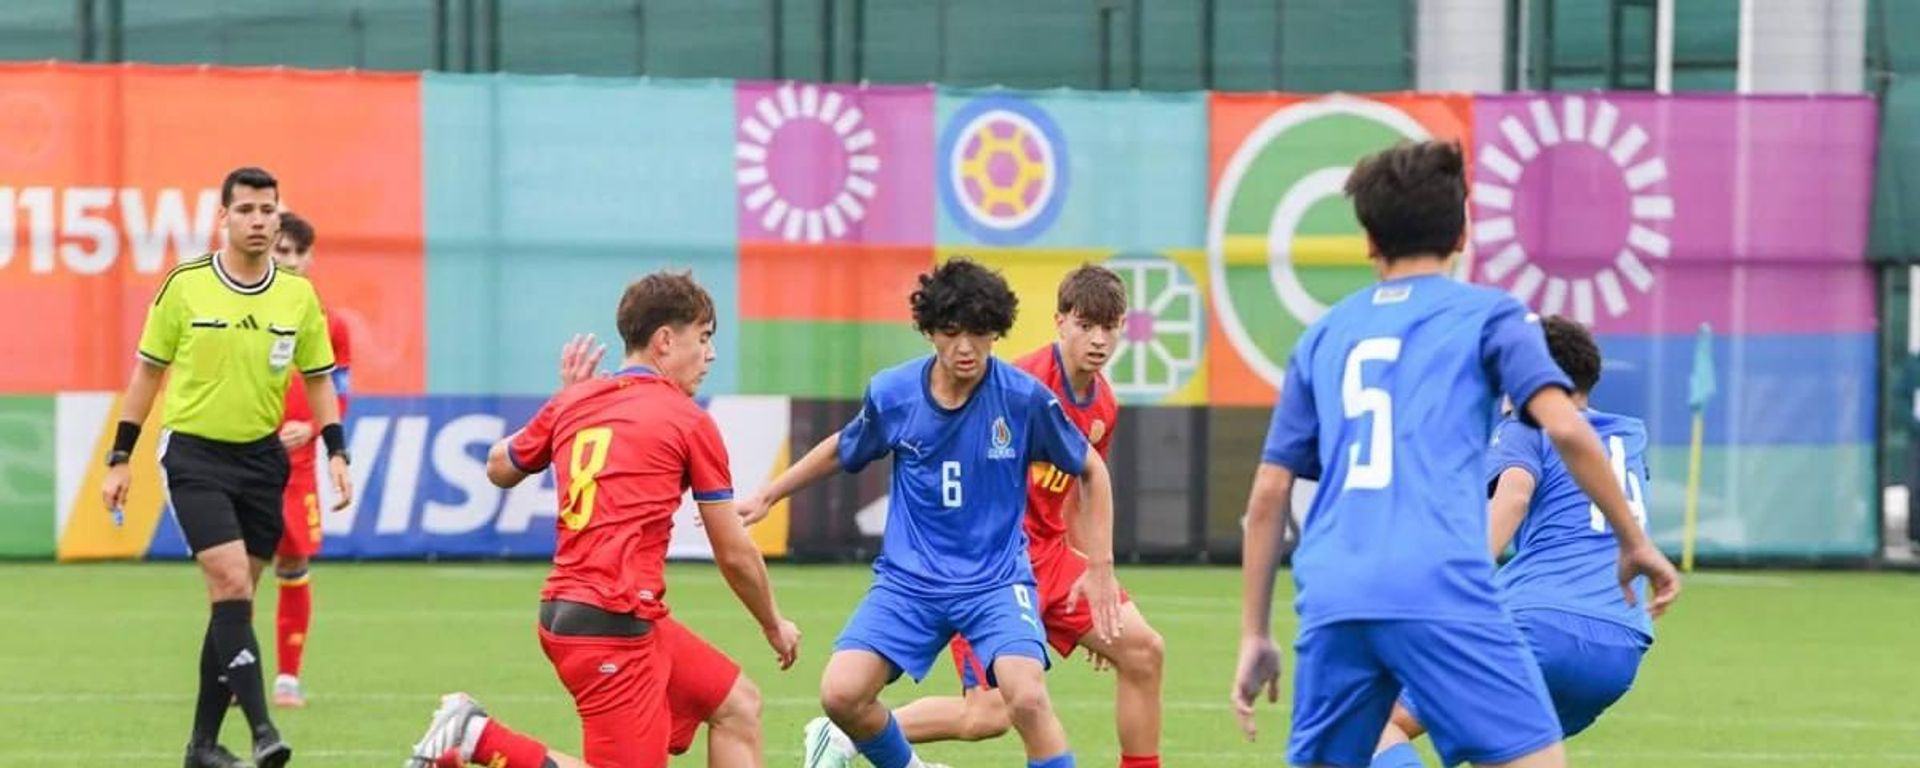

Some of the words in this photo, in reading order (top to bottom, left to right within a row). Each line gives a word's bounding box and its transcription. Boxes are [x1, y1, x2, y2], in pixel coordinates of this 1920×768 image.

[1342, 337, 1402, 491] 5
[561, 426, 613, 531] 8
[942, 461, 962, 507] 6
